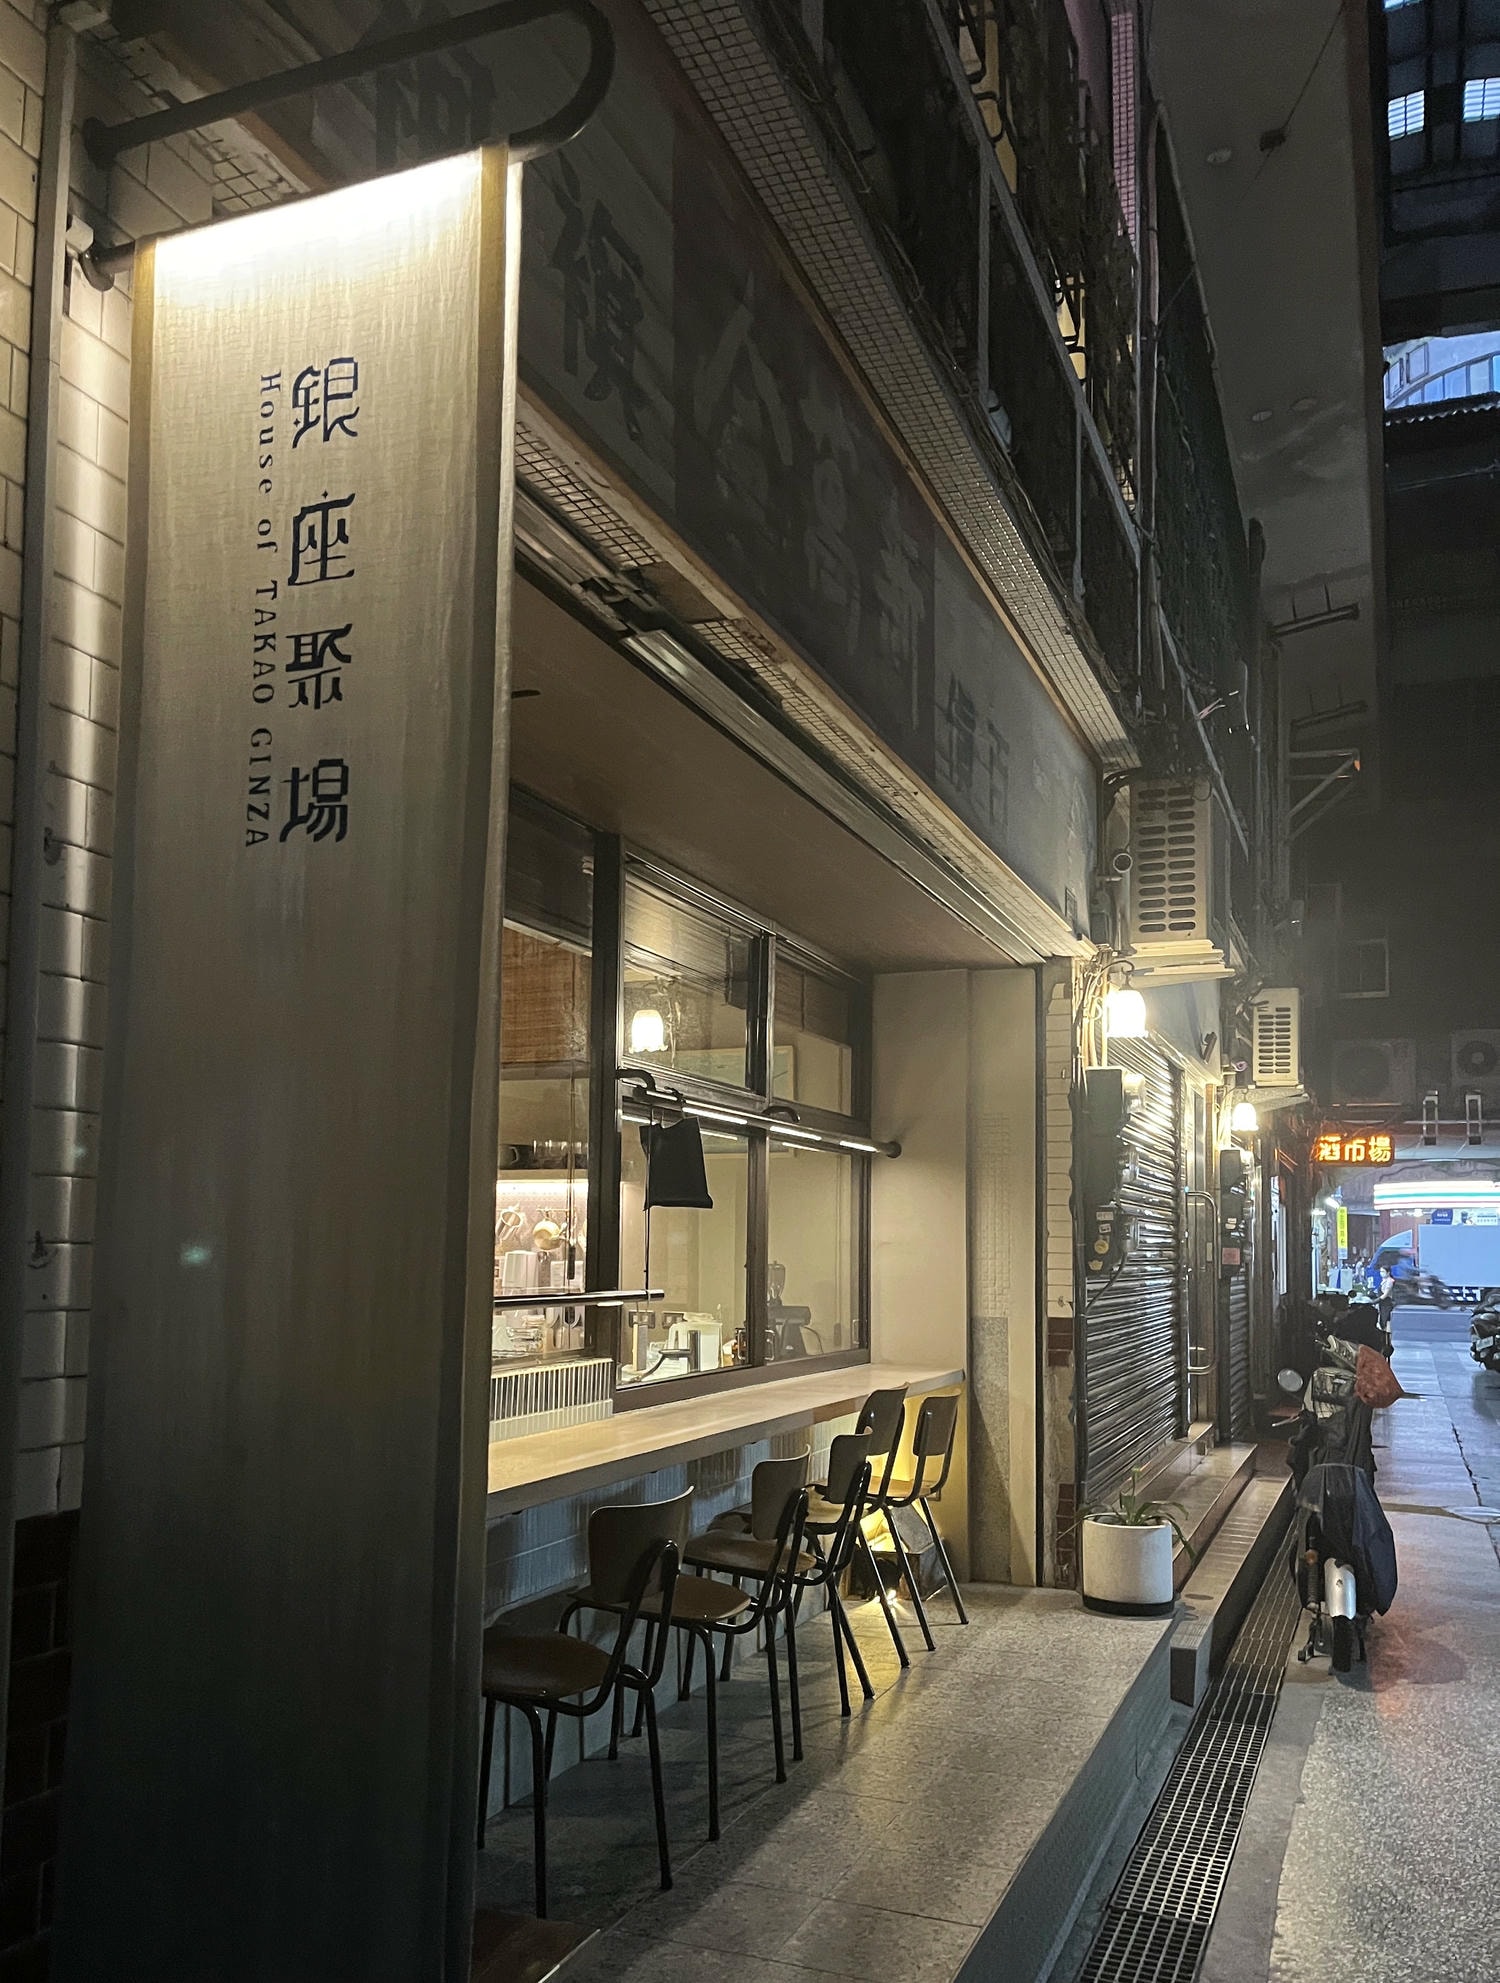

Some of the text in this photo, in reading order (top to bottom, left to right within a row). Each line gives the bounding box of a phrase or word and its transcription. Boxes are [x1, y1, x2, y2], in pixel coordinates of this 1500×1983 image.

[244, 370, 282, 848] House of TAKAO GINZA
[279, 357, 361, 843] 銀座聚場
